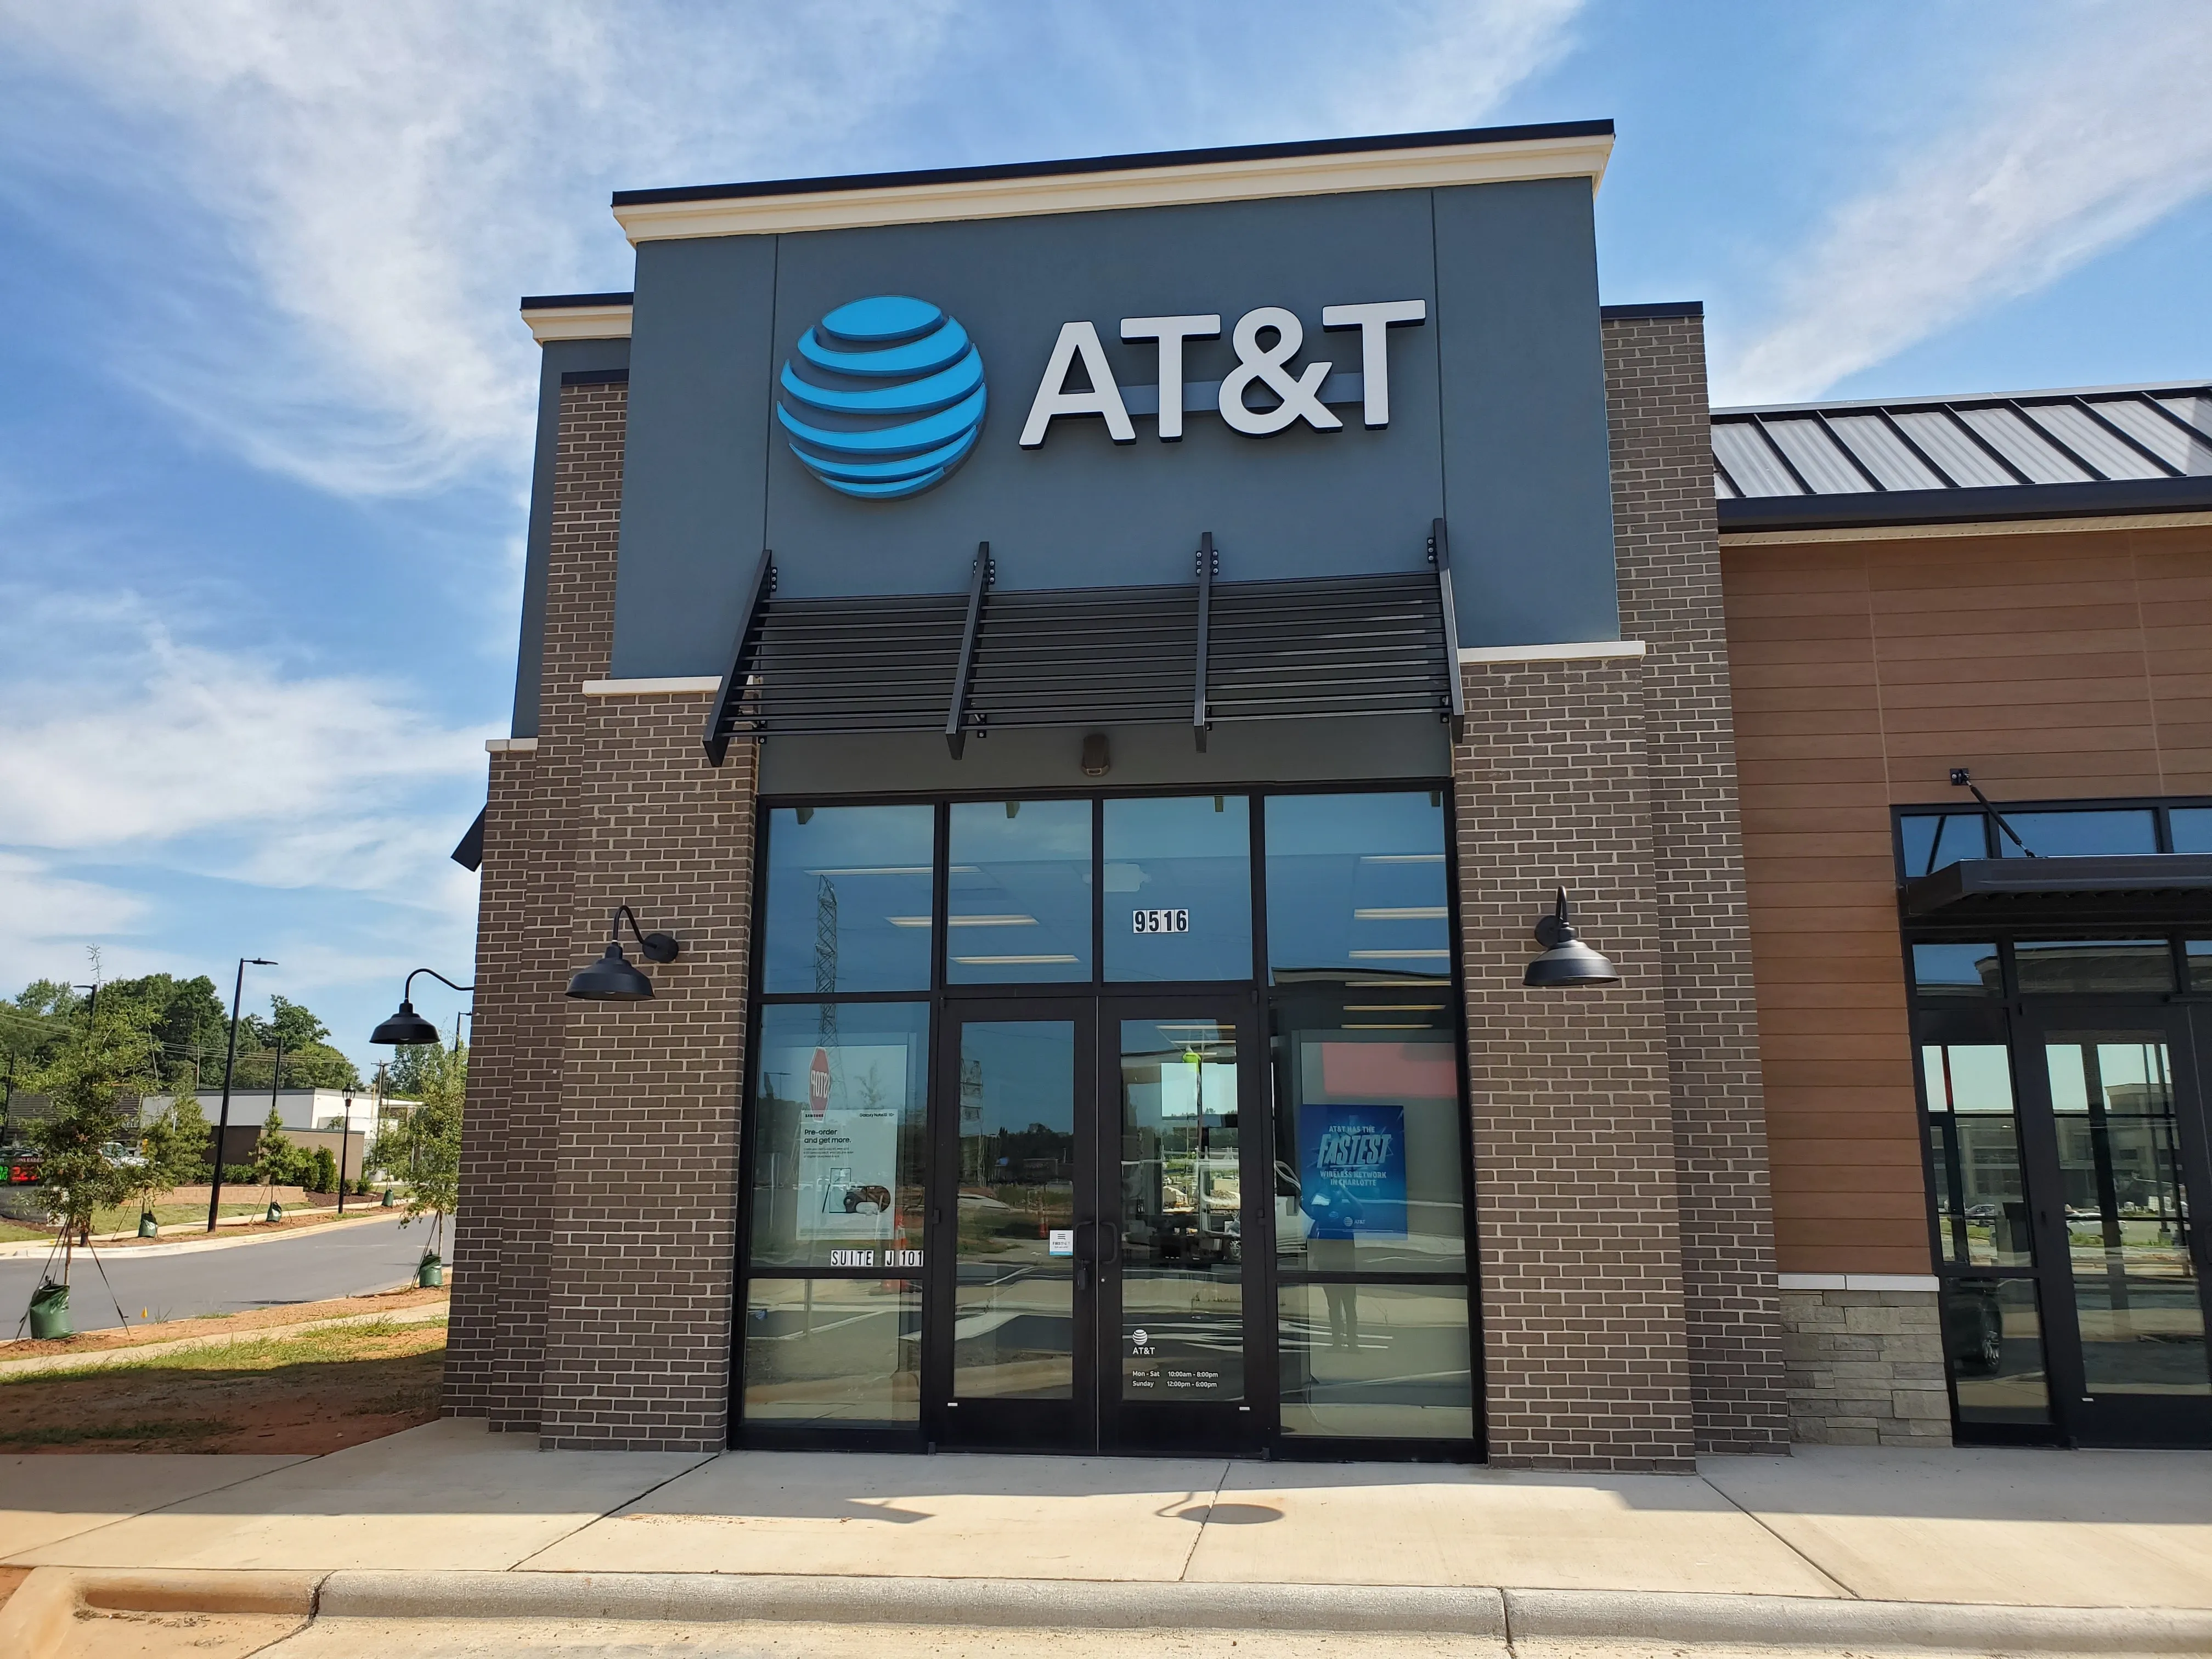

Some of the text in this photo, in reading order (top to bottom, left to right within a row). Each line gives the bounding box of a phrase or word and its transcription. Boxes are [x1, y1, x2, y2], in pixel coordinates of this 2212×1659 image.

[1019, 299, 1426, 450] AT&T
[1135, 910, 1187, 932] 9516
[1317, 1133, 1392, 1168] FASTEST
[832, 1250, 922, 1266] SUITE J 101
